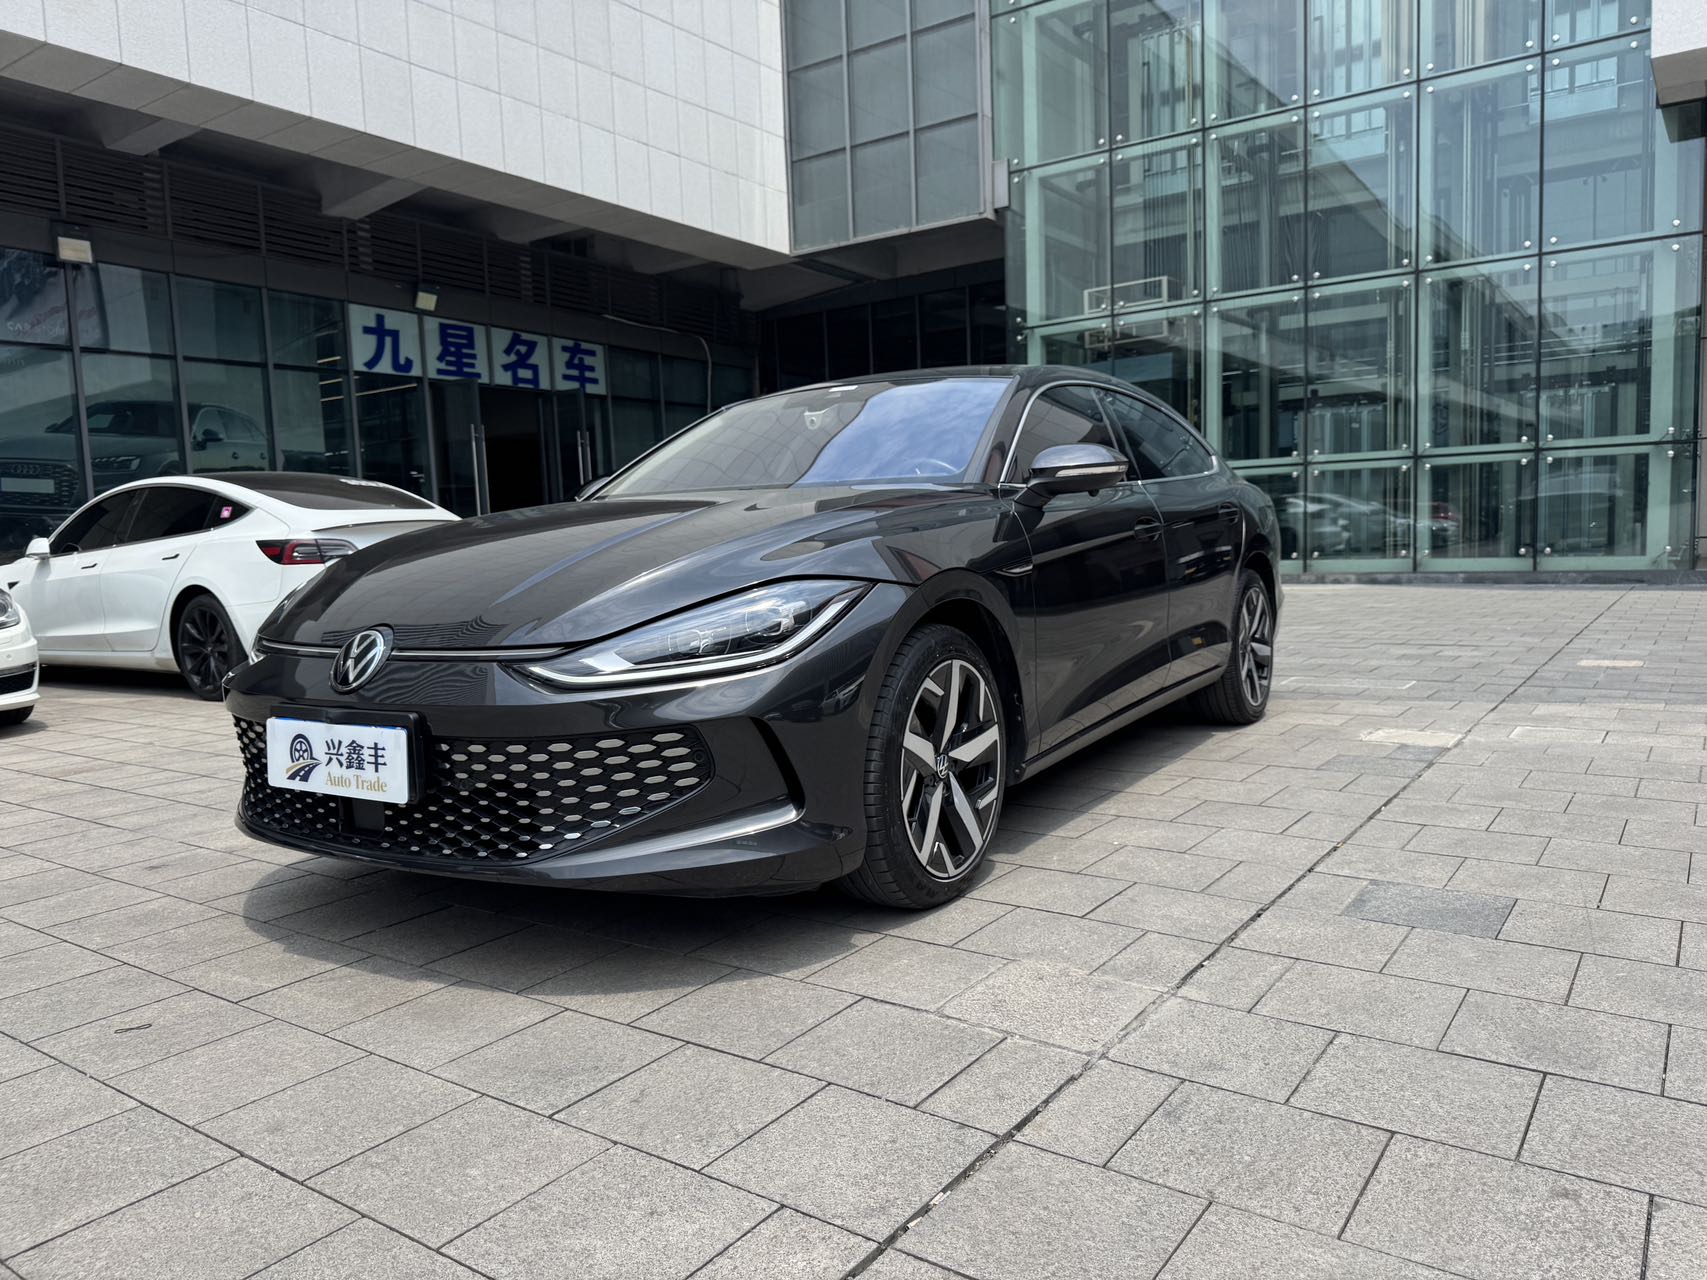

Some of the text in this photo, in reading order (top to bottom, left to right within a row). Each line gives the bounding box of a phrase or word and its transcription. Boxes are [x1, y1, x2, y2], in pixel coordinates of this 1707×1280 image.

[362, 313, 600, 394] 九星名车
[324, 738, 388, 774] 兴鑫丰
[325, 771, 388, 793] Auto Trade
